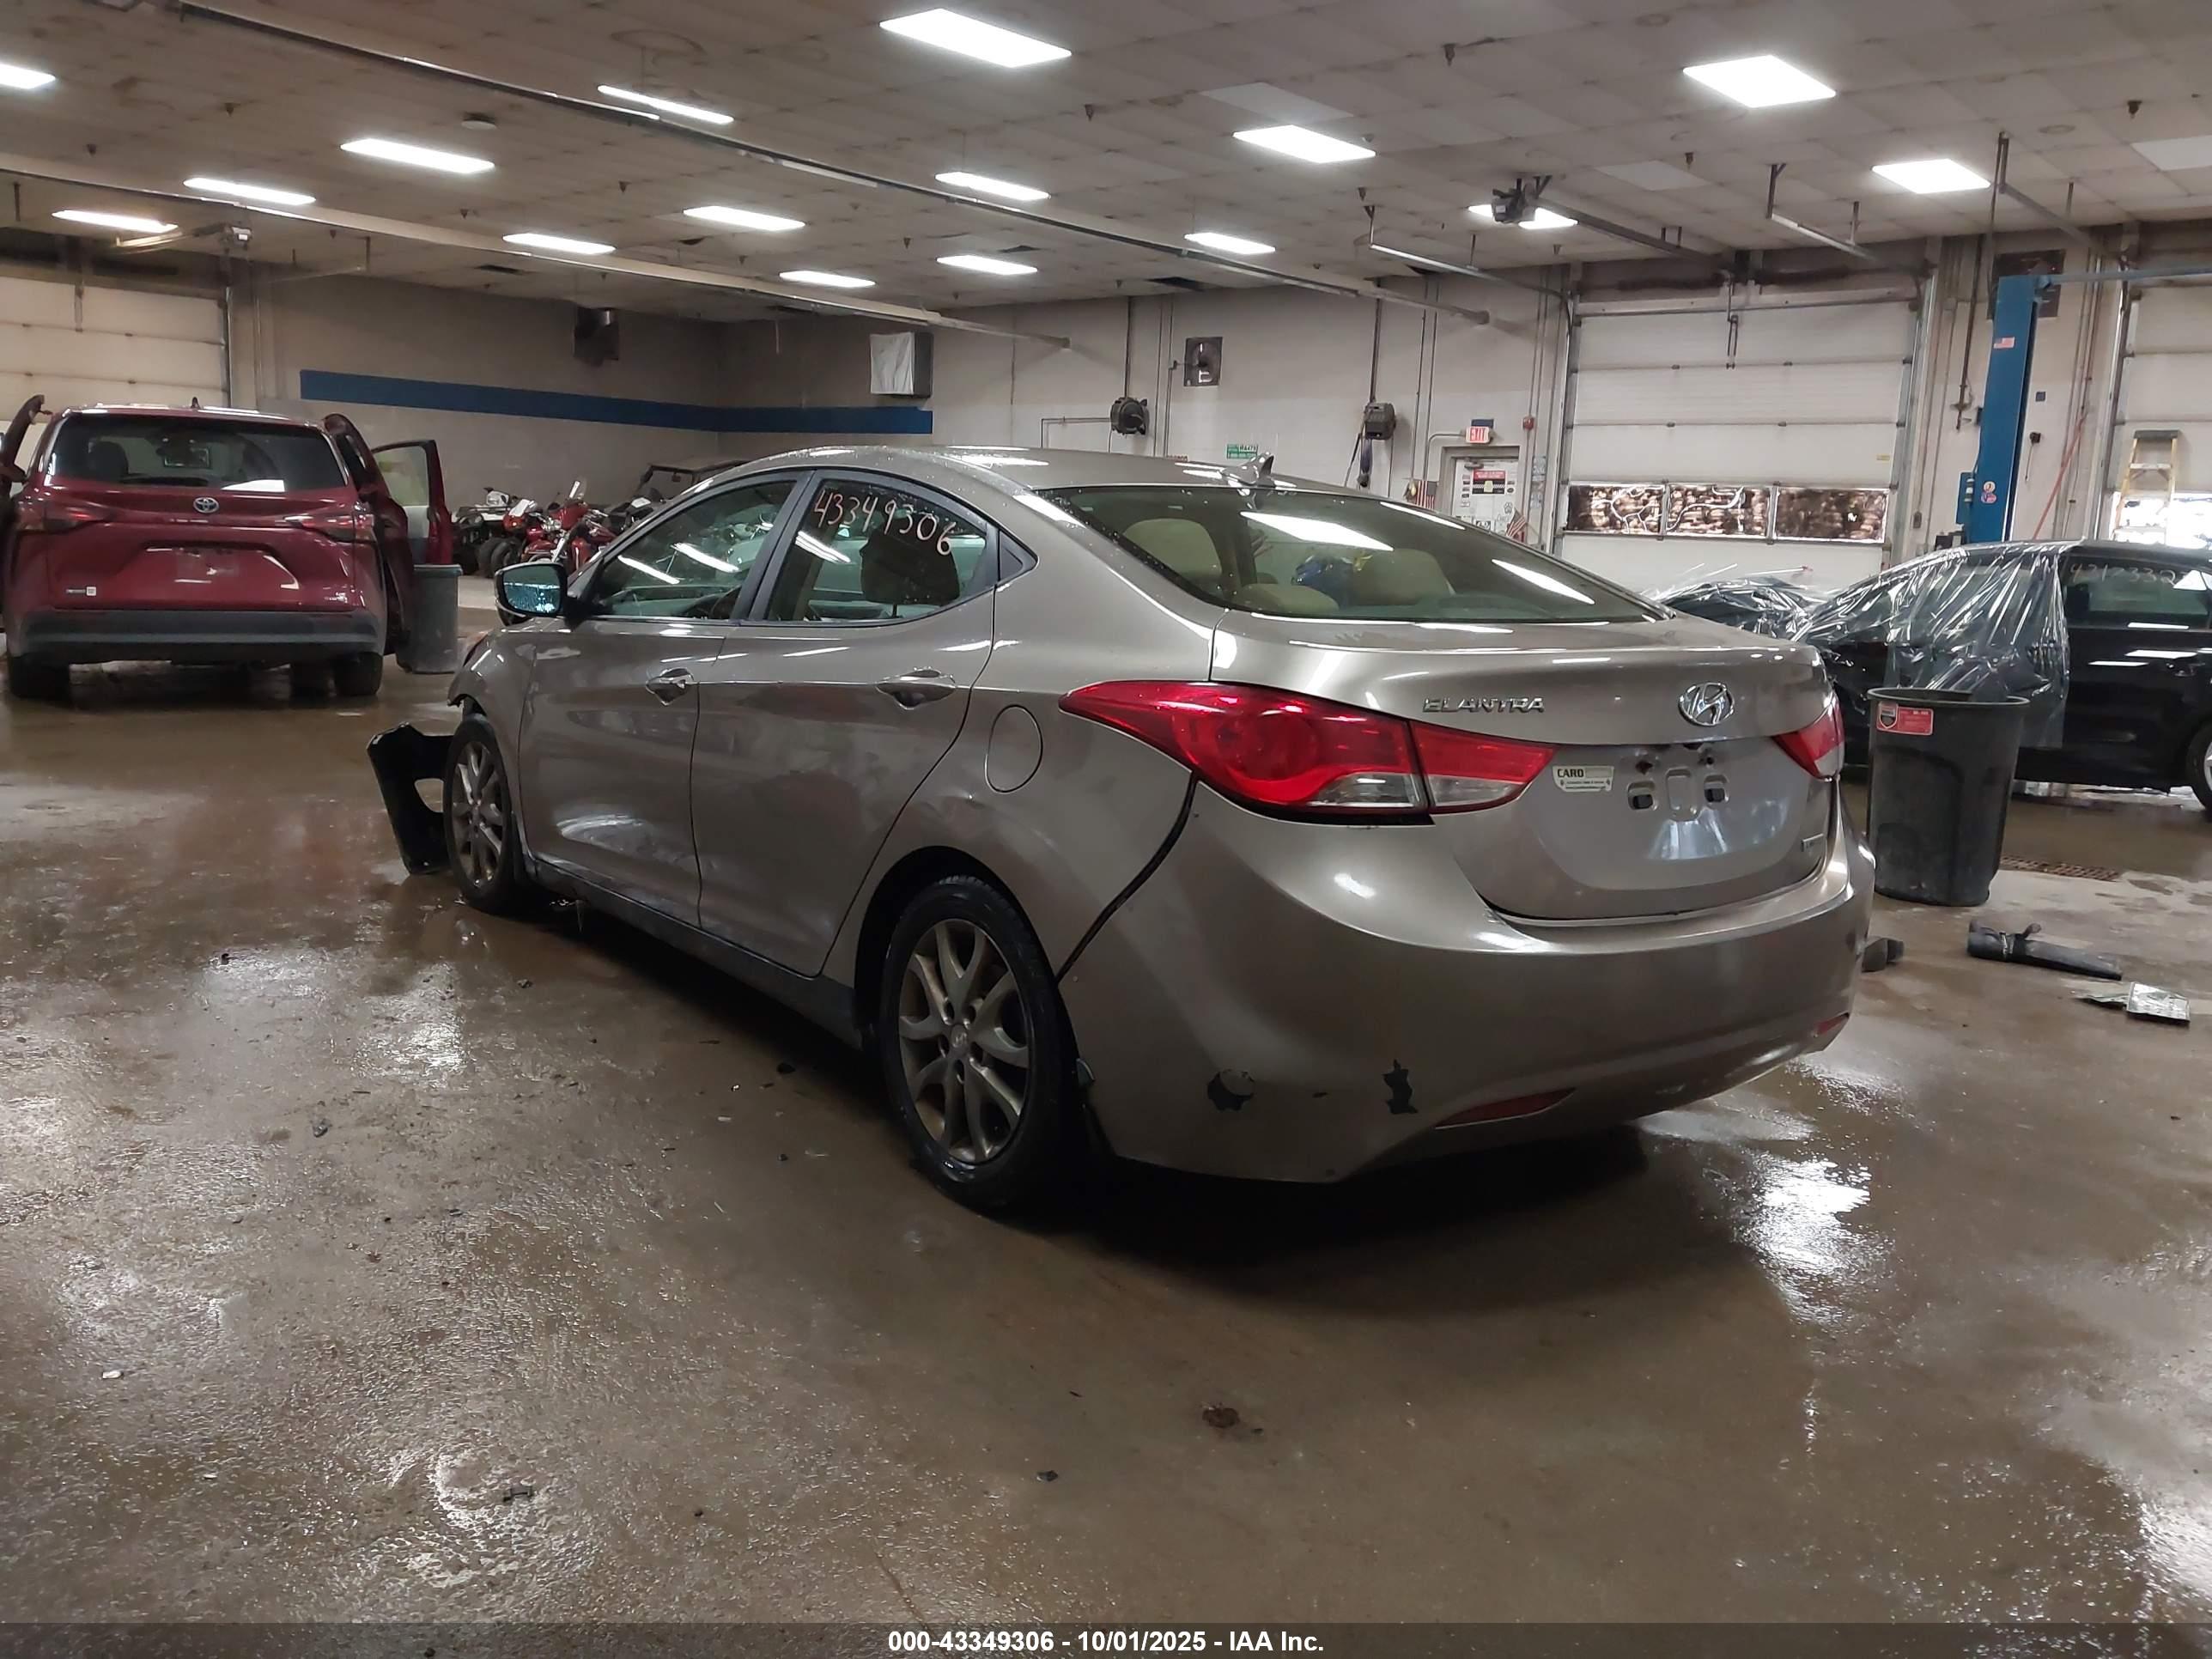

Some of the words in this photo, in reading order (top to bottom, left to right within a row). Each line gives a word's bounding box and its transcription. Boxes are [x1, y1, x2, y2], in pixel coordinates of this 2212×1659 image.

[1470, 428, 1486, 441] EXIT
[814, 489, 957, 555] 43349306
[1422, 697, 1545, 713] ELANTRA
